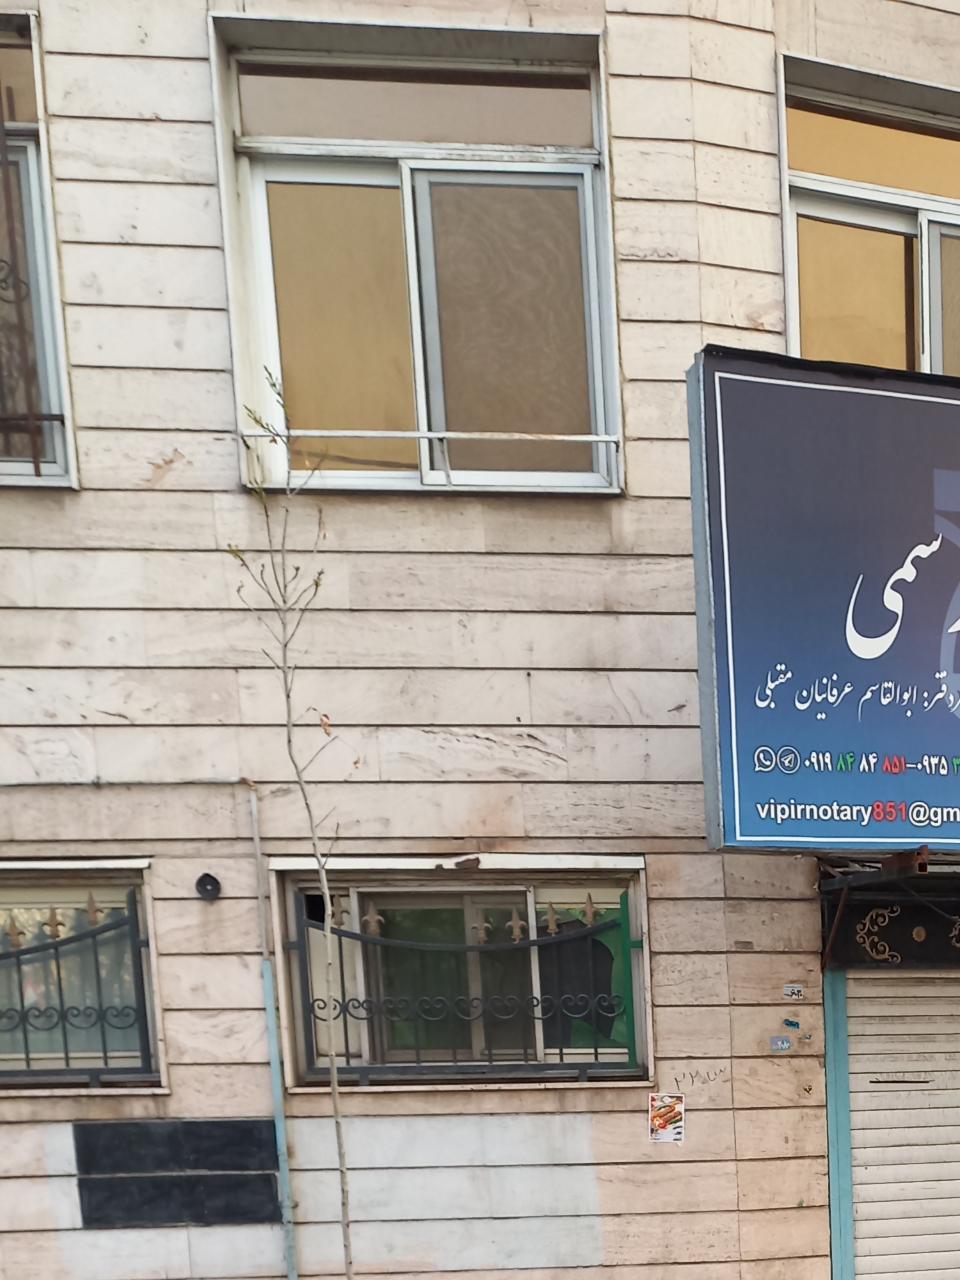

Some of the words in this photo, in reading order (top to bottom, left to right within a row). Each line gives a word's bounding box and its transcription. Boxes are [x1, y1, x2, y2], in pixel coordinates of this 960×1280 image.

[755, 663, 793, 709] مقبلی
[794, 673, 854, 720] عرفانیان
[858, 680, 917, 722] ابوالقاسم
